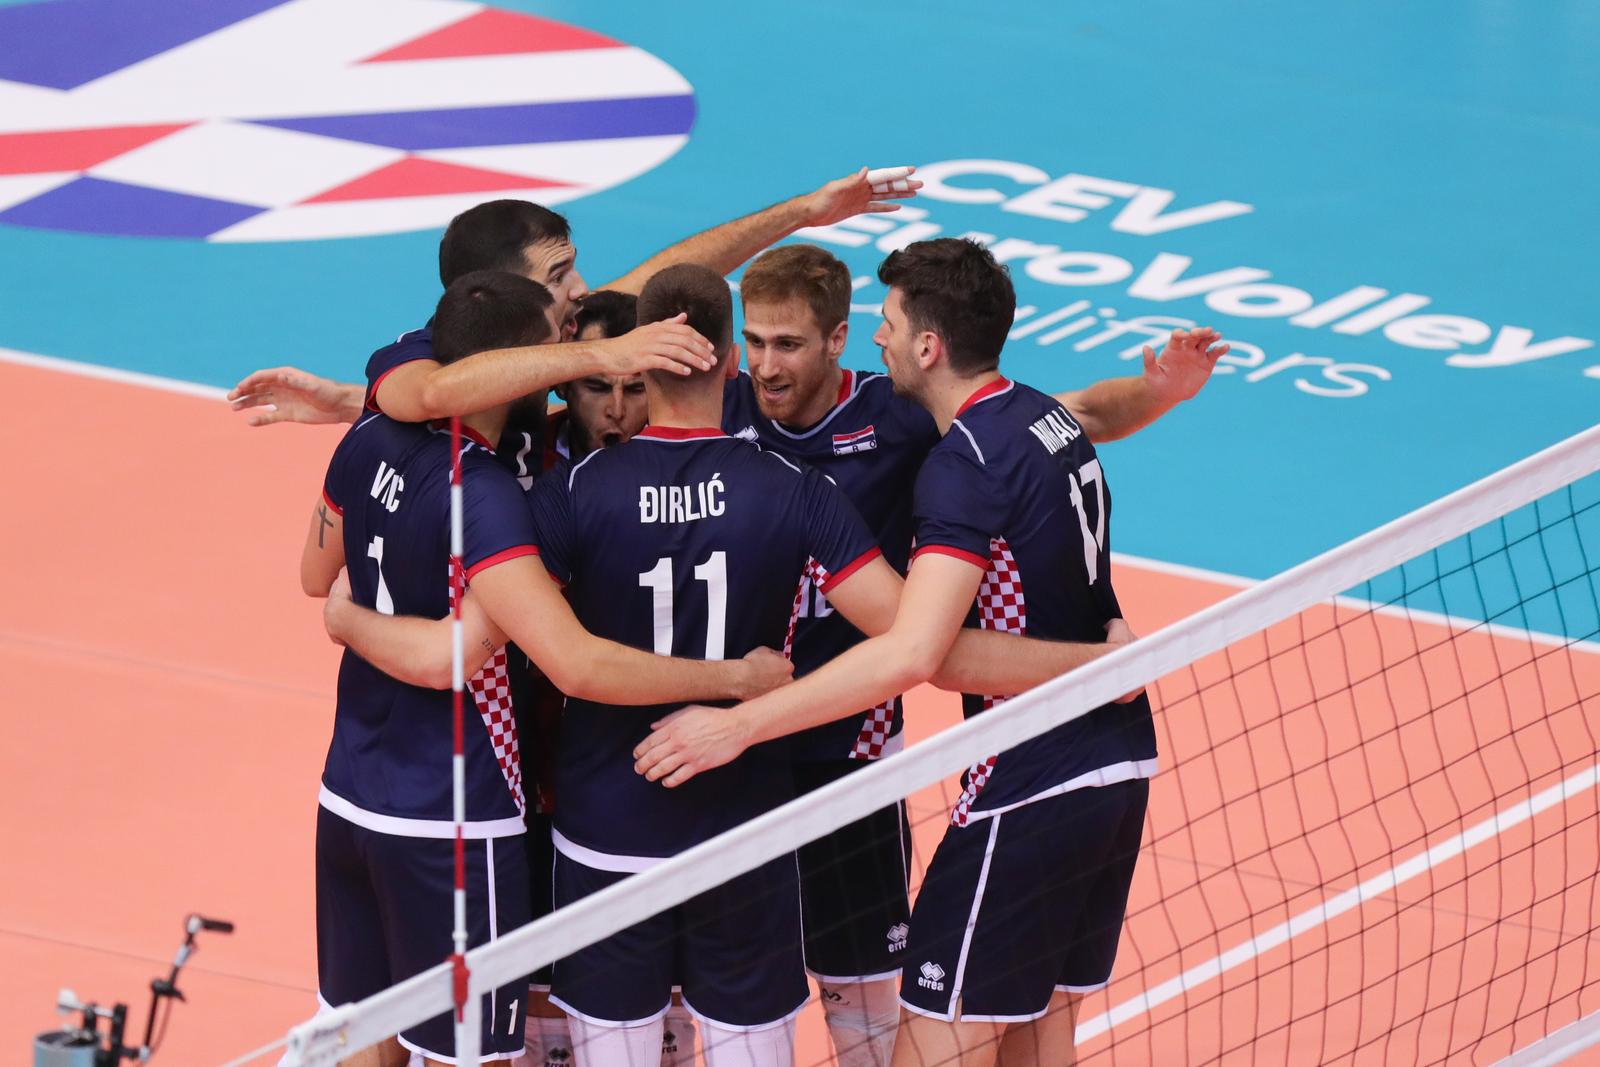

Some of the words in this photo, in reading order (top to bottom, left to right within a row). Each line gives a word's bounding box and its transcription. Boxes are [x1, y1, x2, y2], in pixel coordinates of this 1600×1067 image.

[915, 158, 1253, 236] CEV
[639, 473, 726, 524] ĐIRLIĆ
[1069, 458, 1105, 585] 17
[367, 535, 395, 616] 1
[638, 550, 727, 661] 11
[888, 939, 907, 953] erre
[508, 998, 519, 1035] 1
